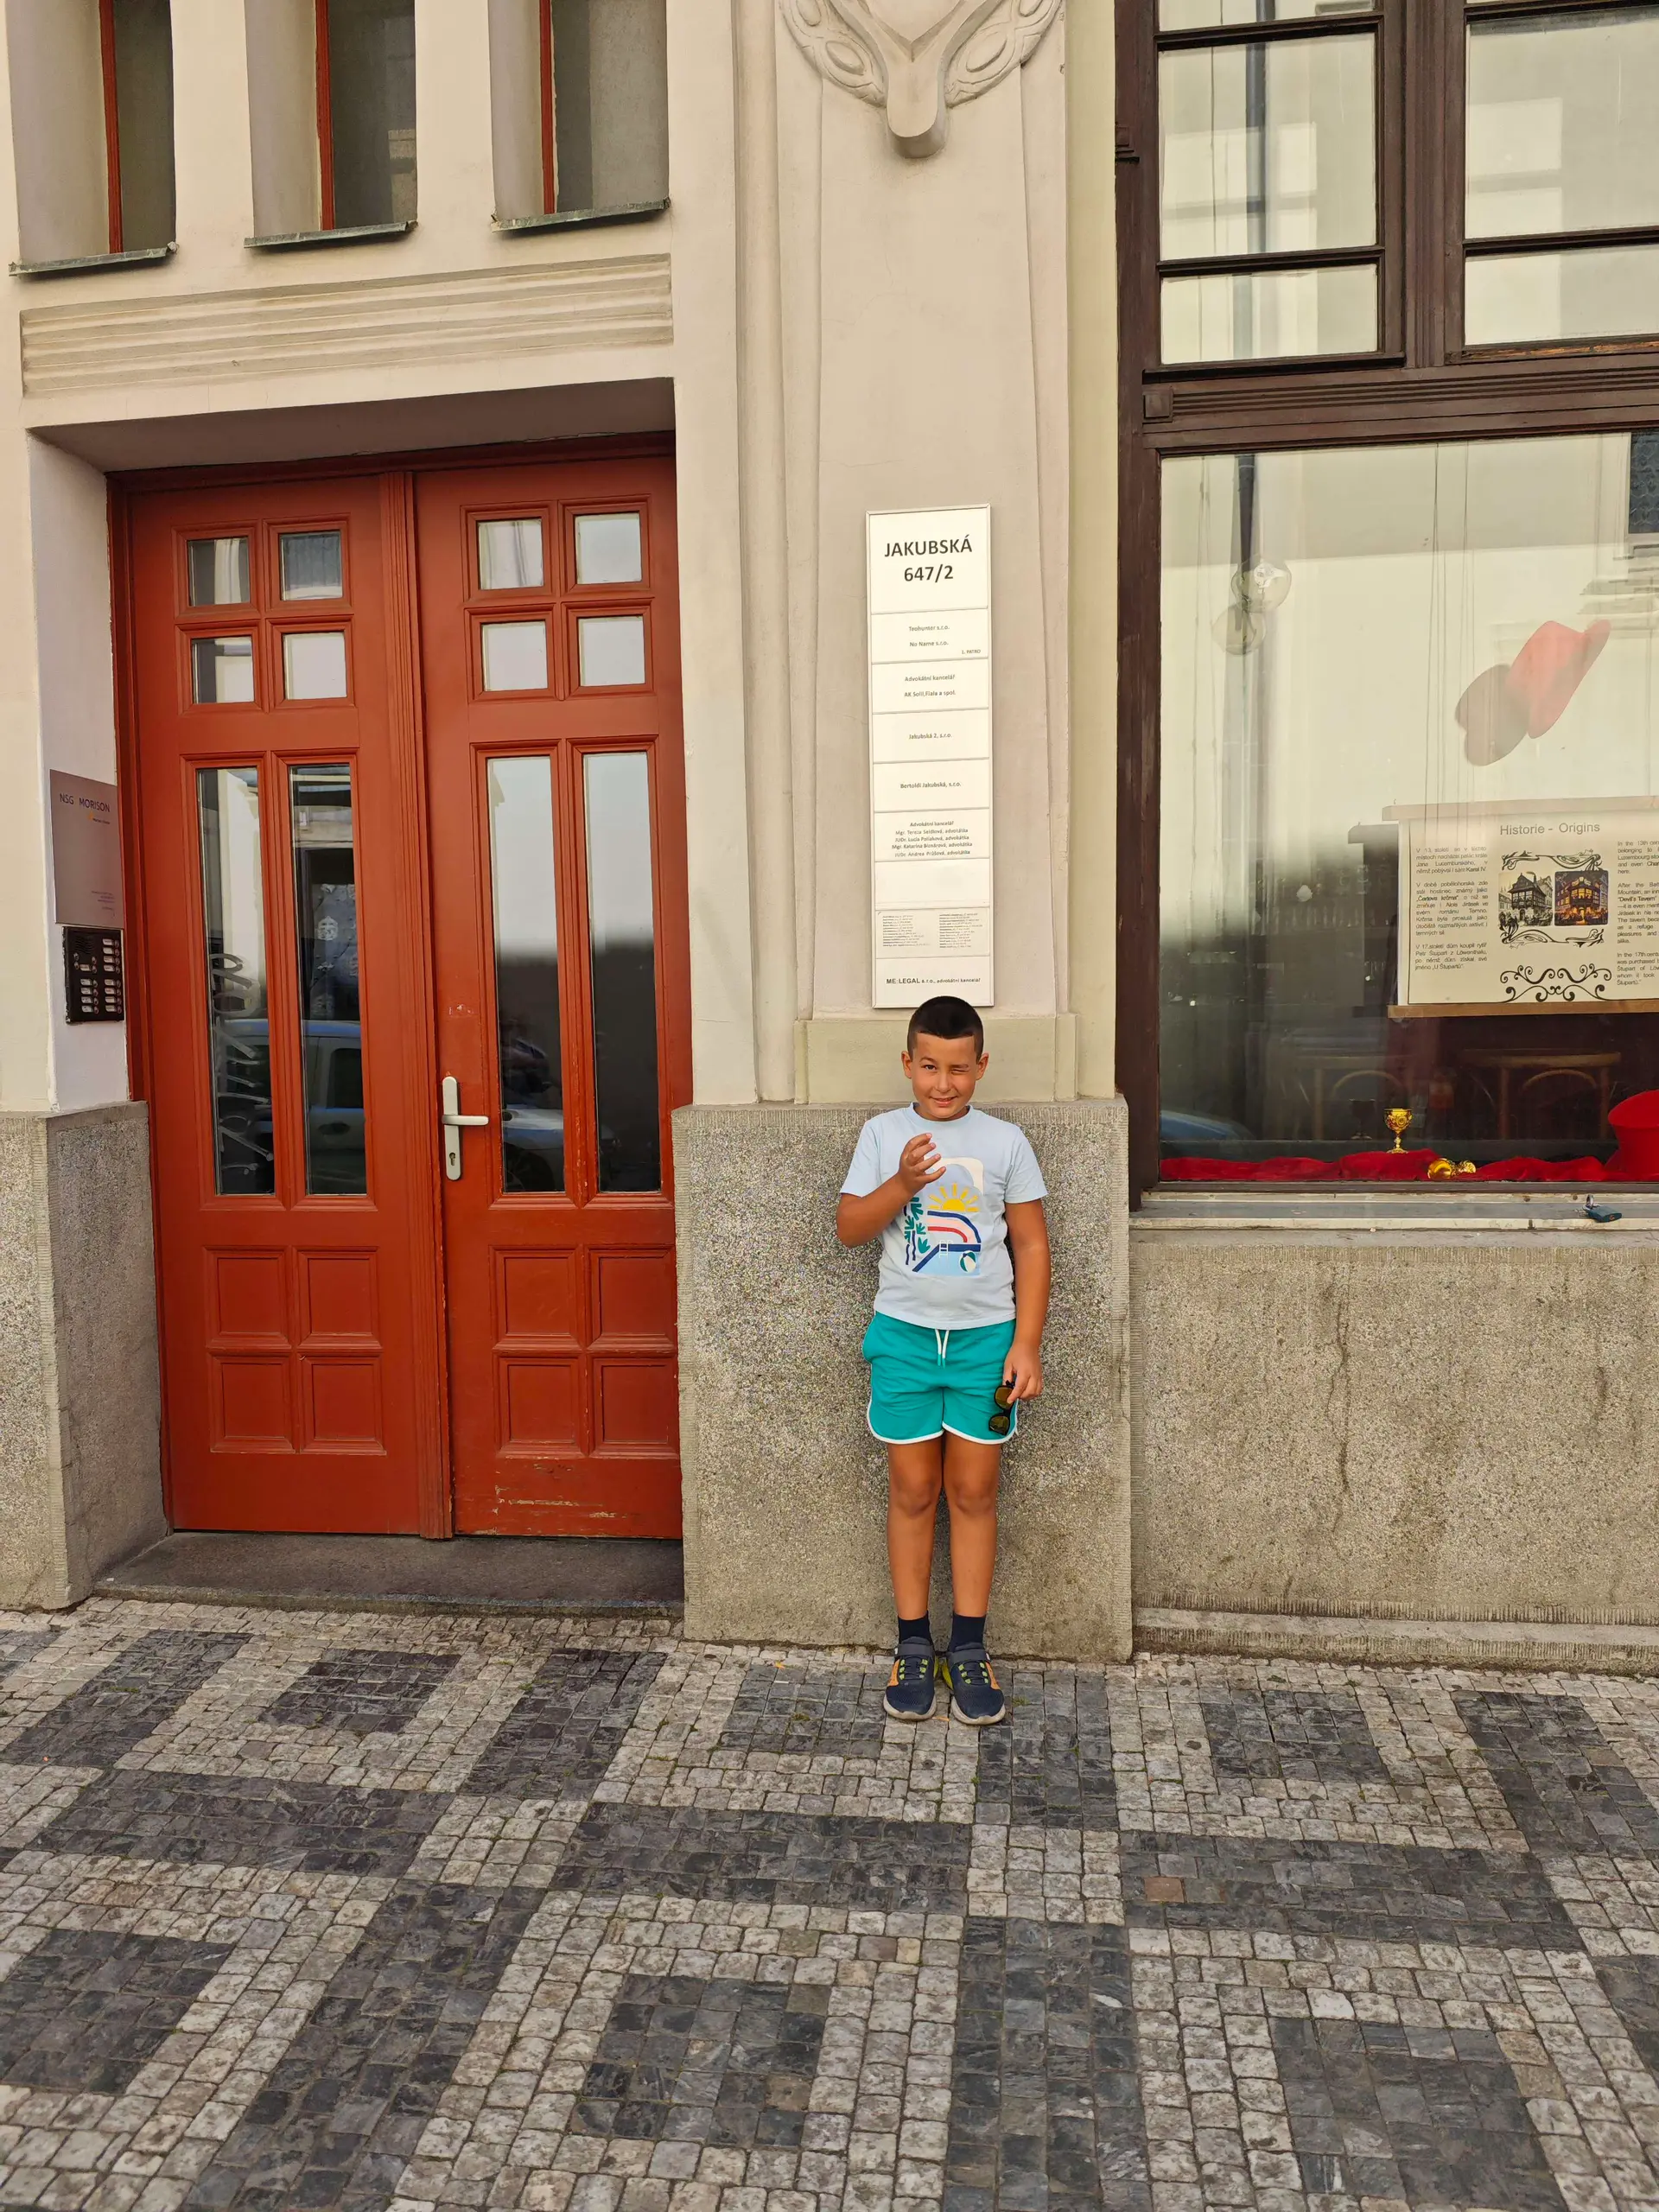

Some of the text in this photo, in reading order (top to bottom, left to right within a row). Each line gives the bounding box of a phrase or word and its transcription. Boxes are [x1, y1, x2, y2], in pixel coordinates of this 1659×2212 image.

[884, 534, 972, 557] JAKUBSKÁ
[904, 564, 953, 582] 647/2
[60, 793, 110, 812] NSG MORISON
[1500, 824, 1545, 835] Historie
[1559, 823, 1600, 835] Origins
